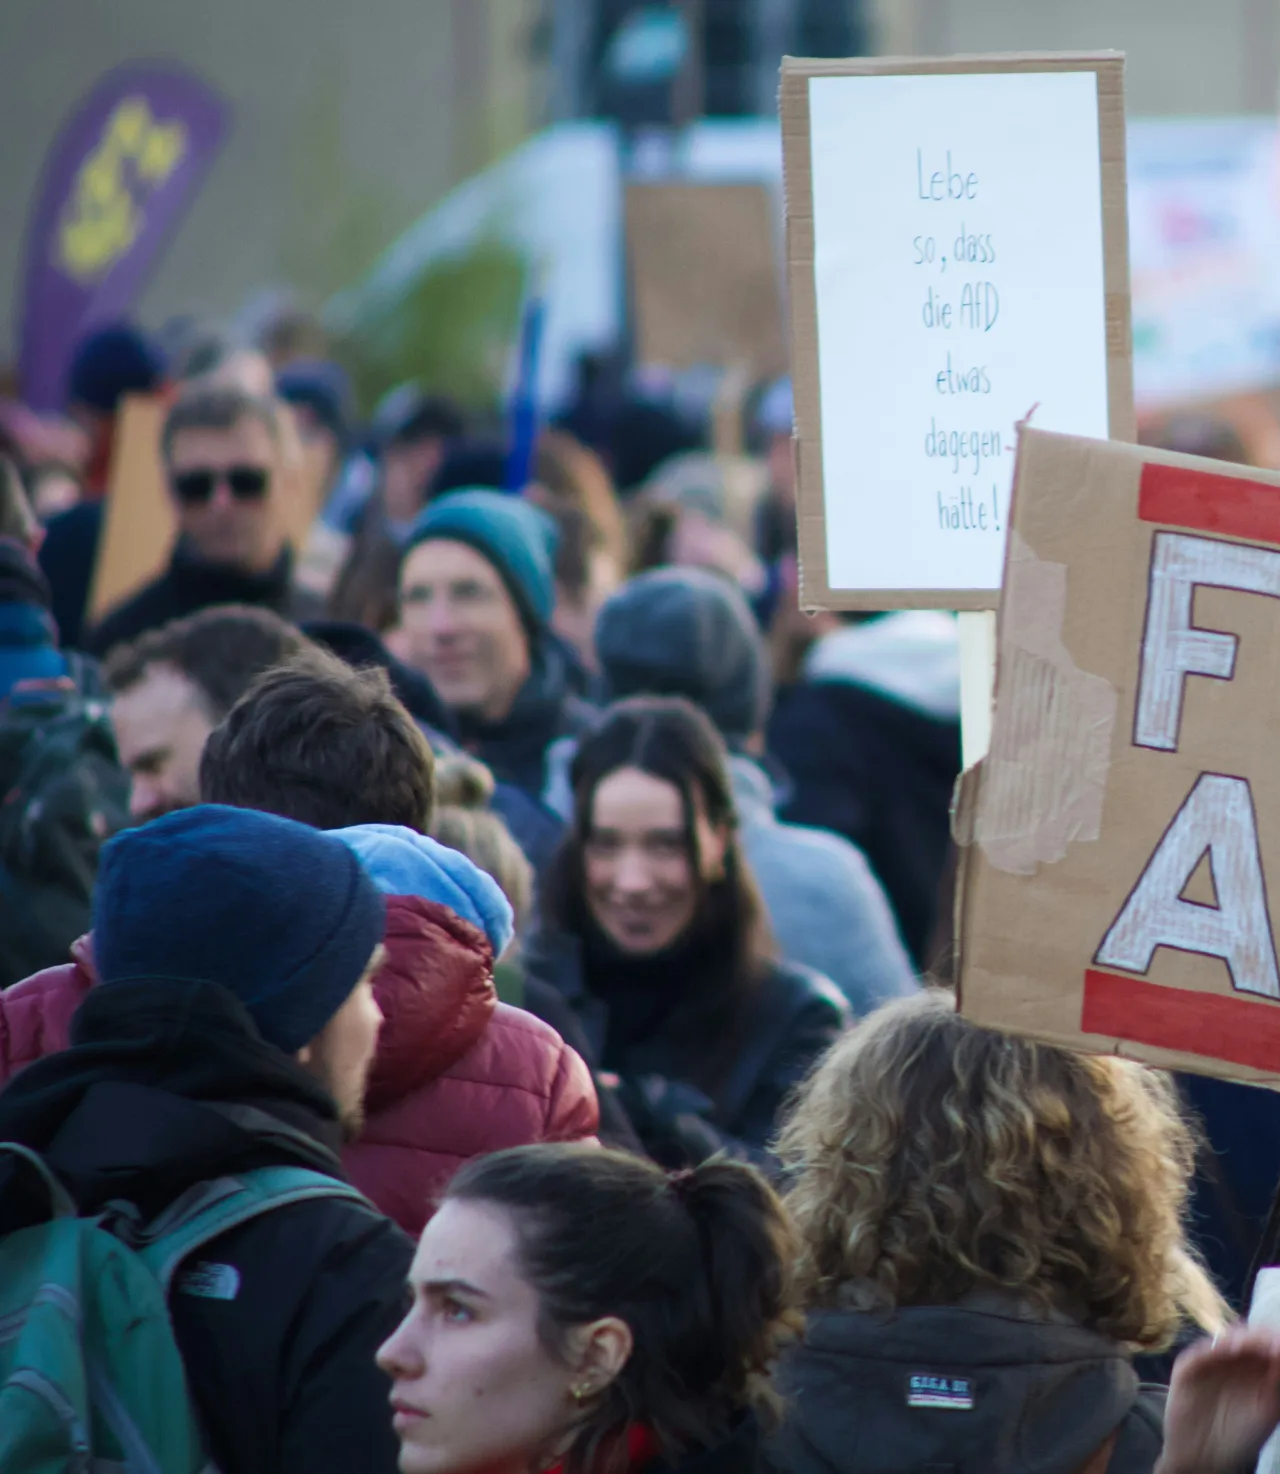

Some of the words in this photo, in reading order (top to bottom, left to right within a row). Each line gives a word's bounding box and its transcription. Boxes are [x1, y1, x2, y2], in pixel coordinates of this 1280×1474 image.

[917, 147, 979, 201] Lebe
[913, 235, 947, 273] so,
[954, 221, 996, 264] dass
[922, 285, 952, 329] die
[960, 281, 1000, 332] AfD
[936, 350, 992, 394] etwas
[925, 416, 1001, 476] dagegen
[937, 483, 1001, 531] hätte!
